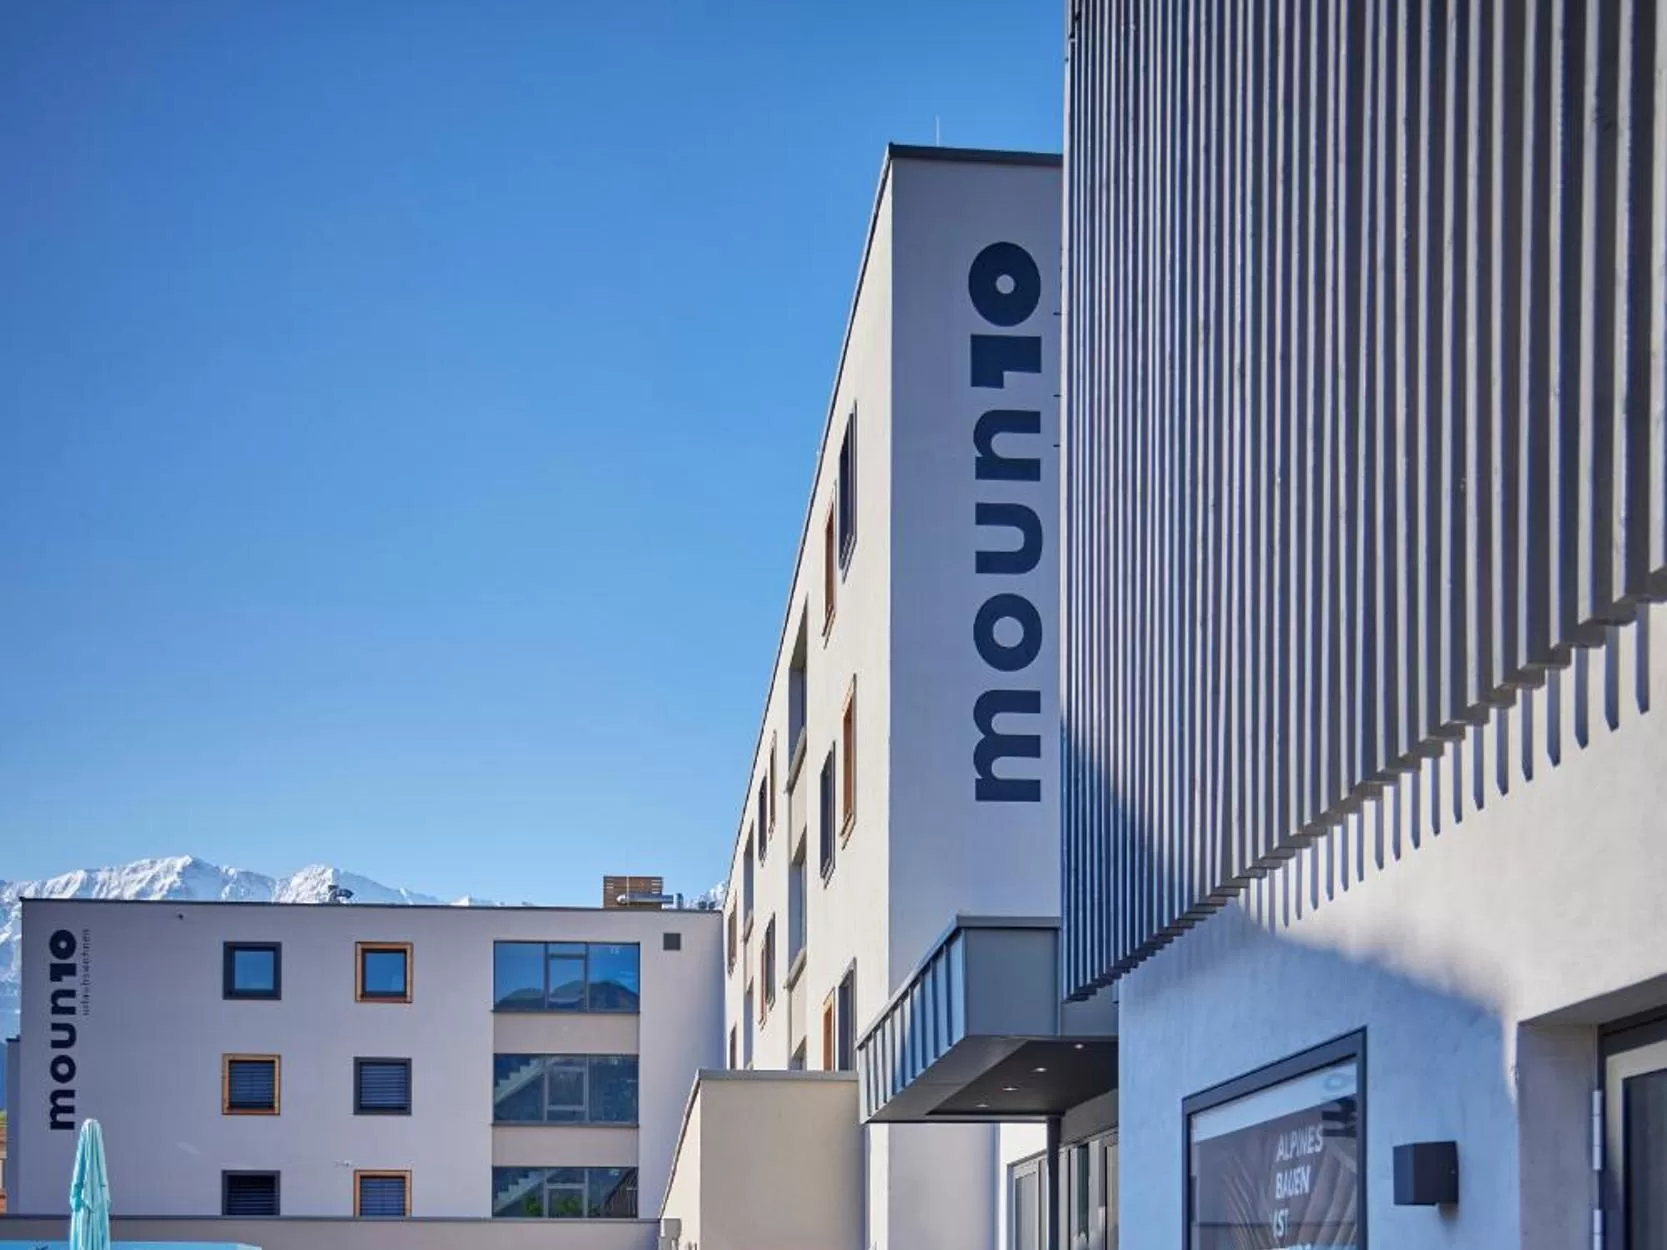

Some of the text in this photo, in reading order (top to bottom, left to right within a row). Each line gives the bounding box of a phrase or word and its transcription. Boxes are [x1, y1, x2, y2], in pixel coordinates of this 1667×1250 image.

[968, 240, 1043, 802] moun10
[49, 929, 77, 1131] moun10
[1275, 1123, 1324, 1162] ALPINES
[1275, 1165, 1311, 1199] BAUEN
[1272, 1207, 1289, 1239] IST
